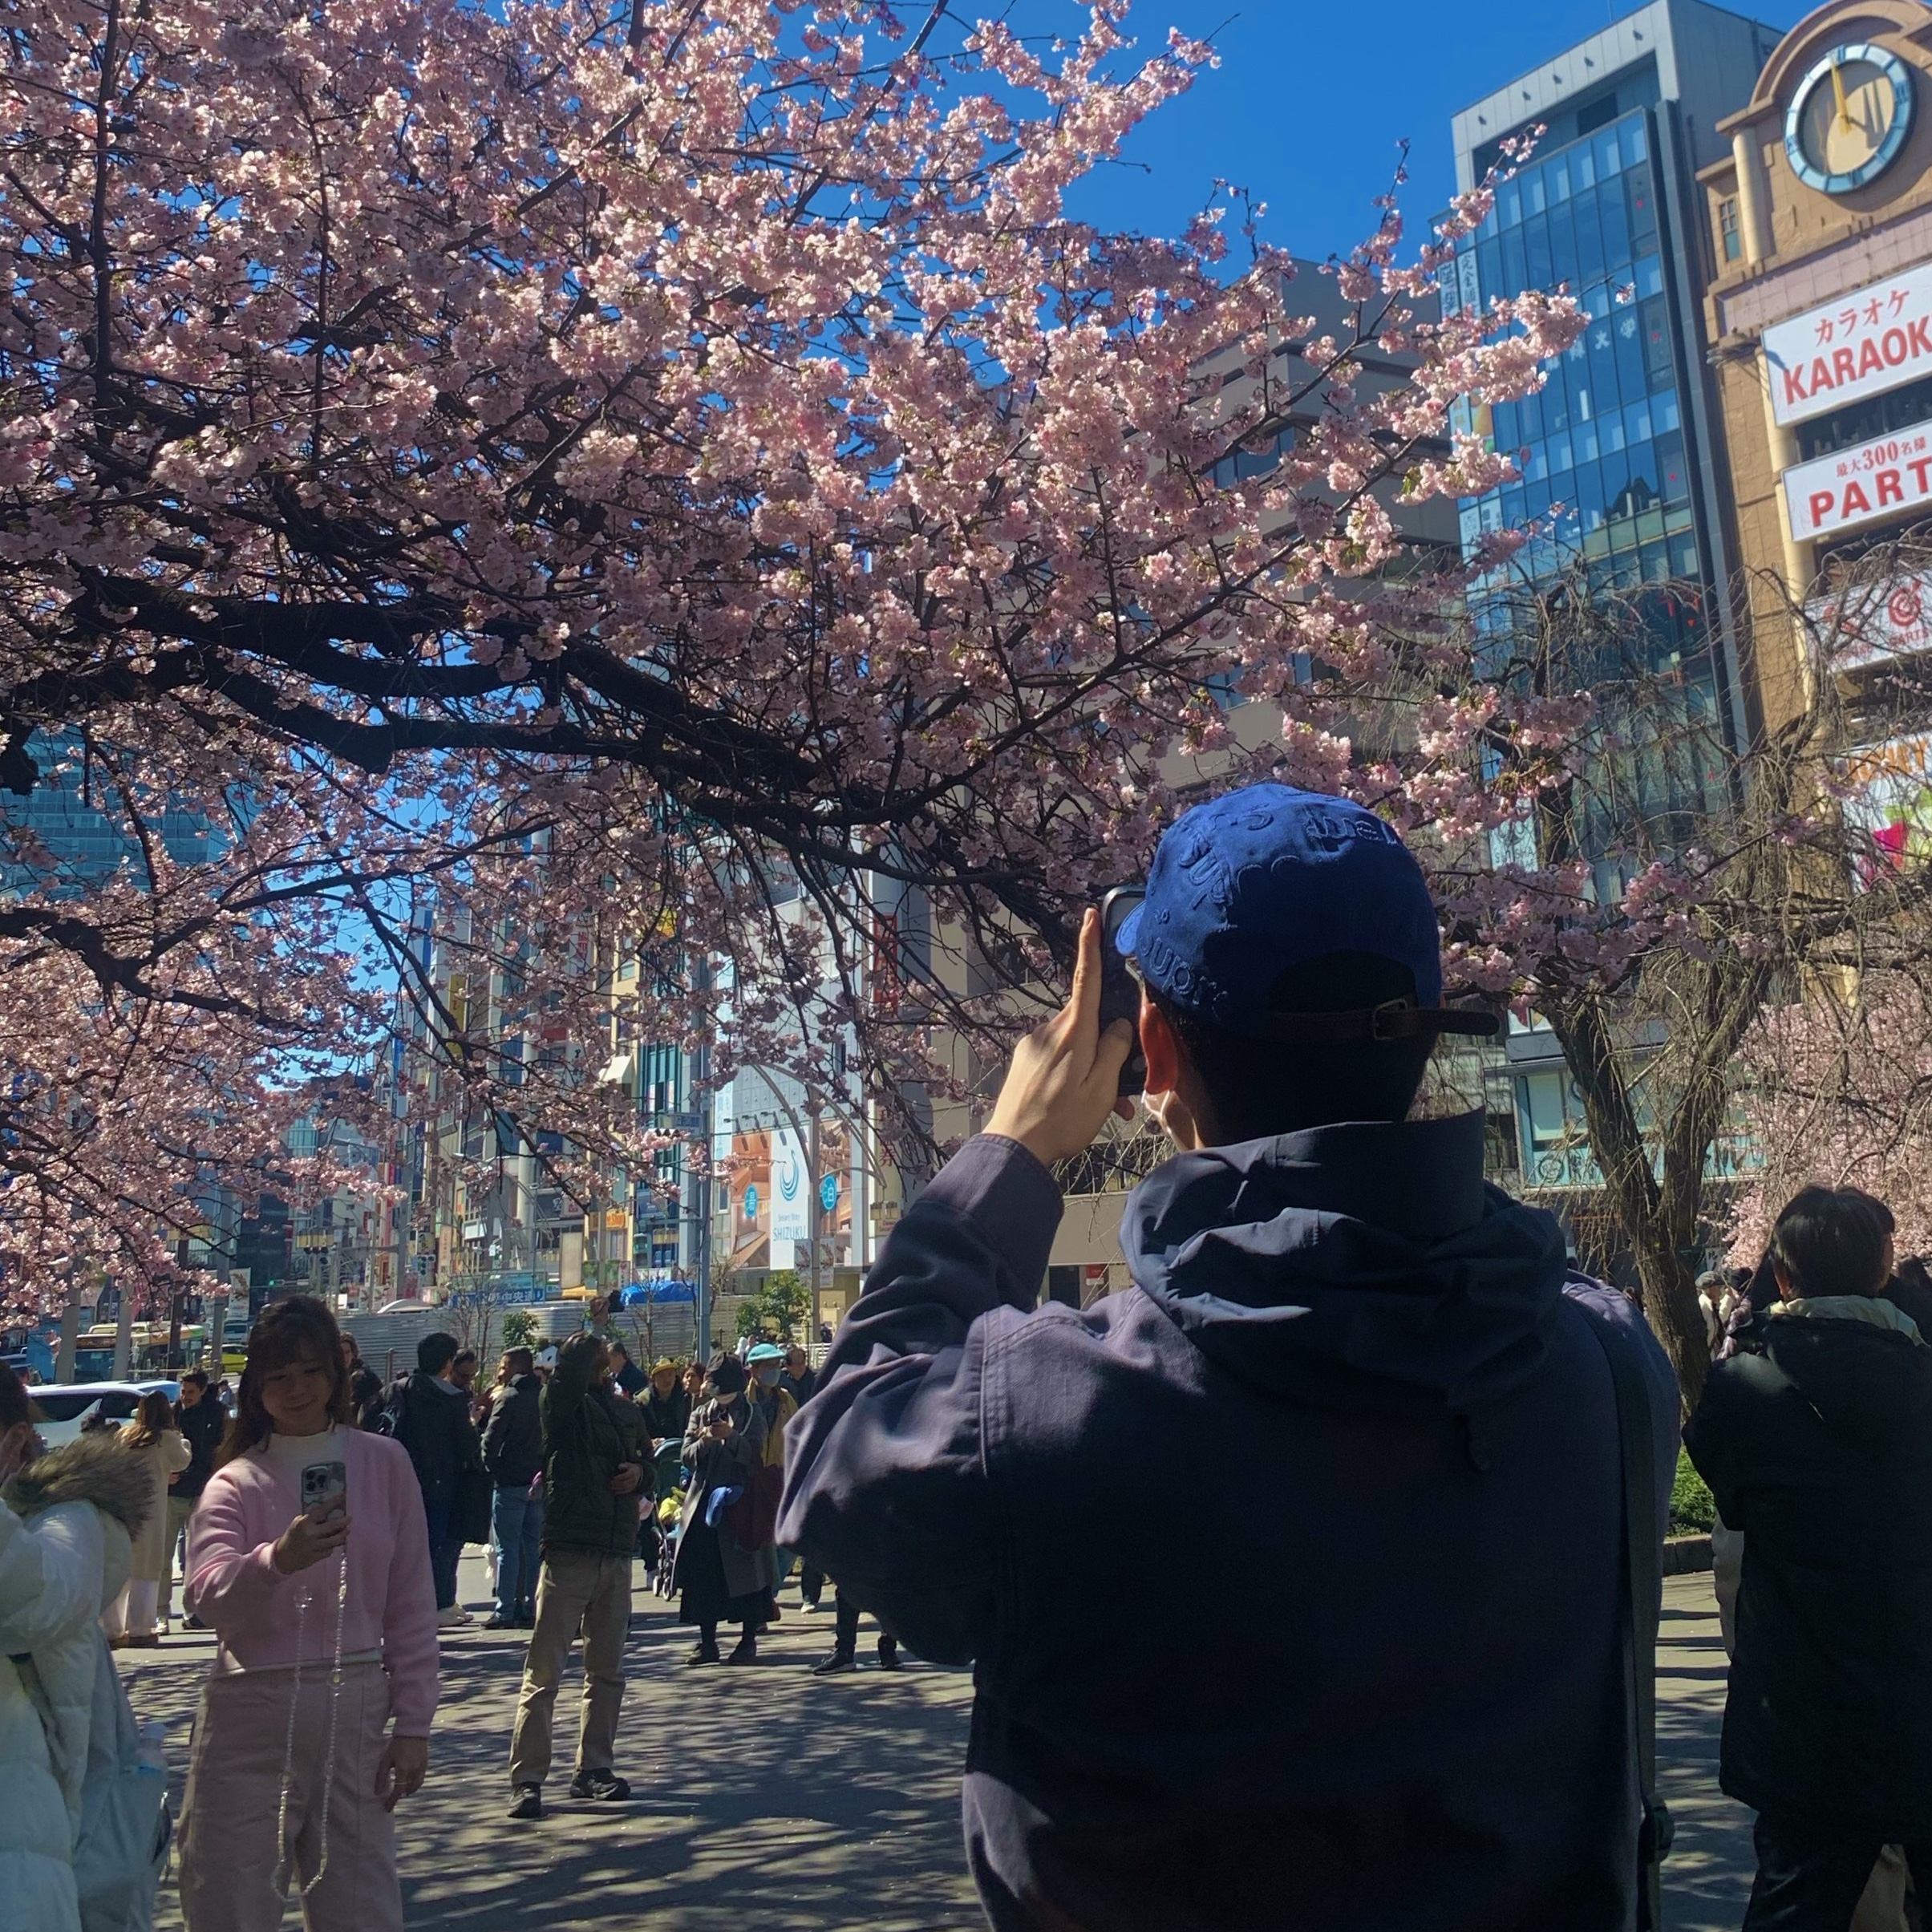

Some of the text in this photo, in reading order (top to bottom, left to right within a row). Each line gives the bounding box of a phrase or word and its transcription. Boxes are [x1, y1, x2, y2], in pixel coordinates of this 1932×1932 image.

[1814, 289, 1910, 347] カラオケ
[1783, 314, 1932, 405] KARAOK
[1836, 435, 1926, 478] 最大300名様
[1808, 455, 1932, 528] PART
[823, 1182, 836, 1202] 泊
[772, 1225, 806, 1241] SHIZUKU
